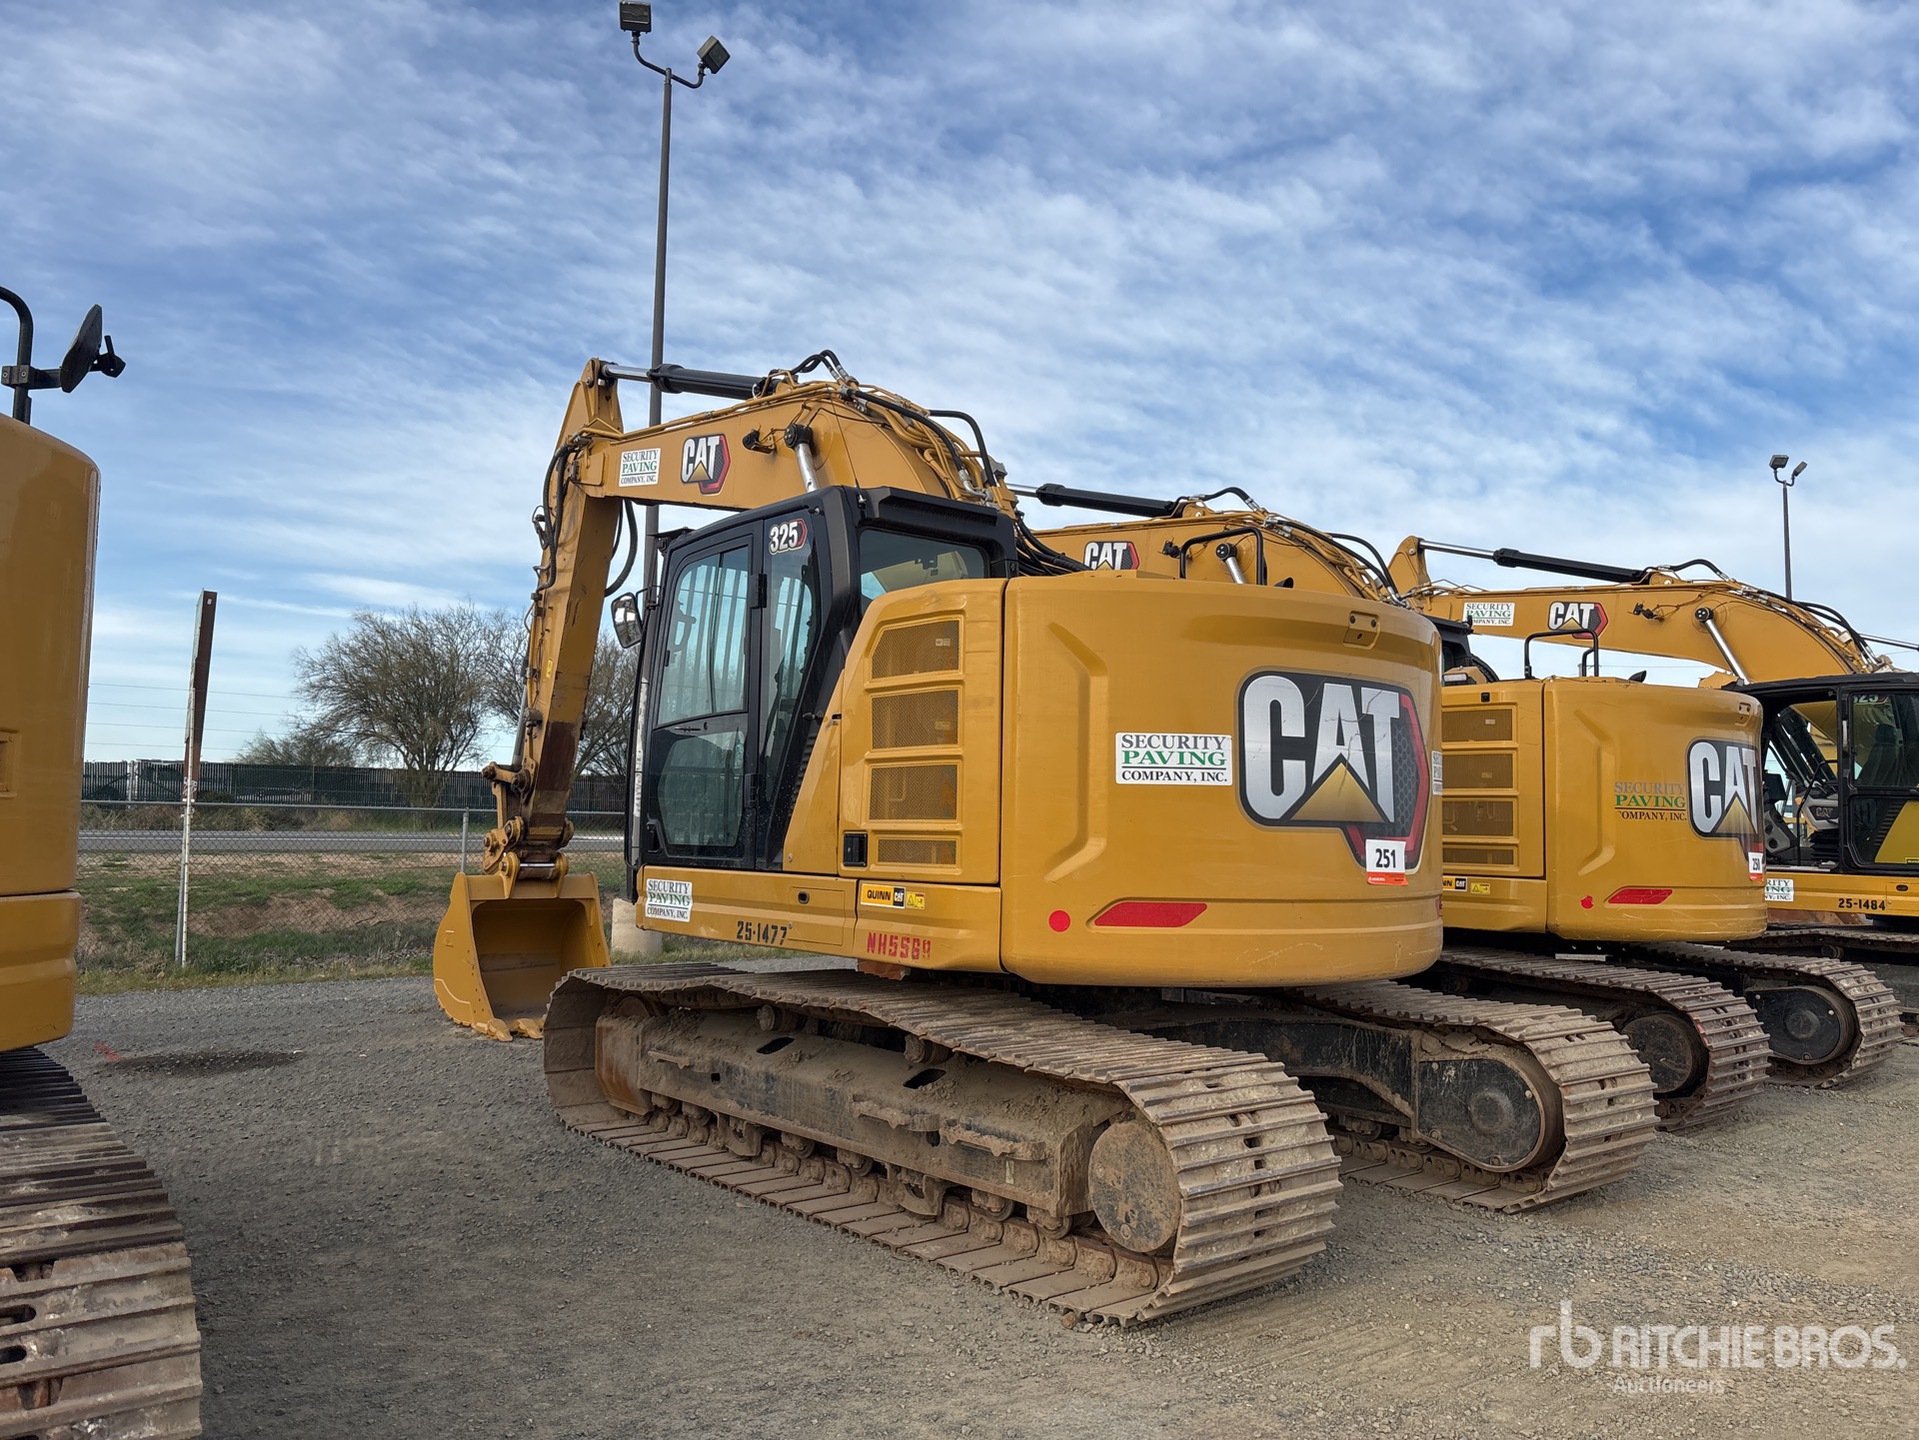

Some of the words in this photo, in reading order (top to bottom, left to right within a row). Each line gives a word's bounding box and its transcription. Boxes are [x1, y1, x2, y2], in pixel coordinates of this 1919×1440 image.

[623, 450, 659, 462] SECURITY
[682, 435, 720, 483] CAT
[622, 461, 657, 473] PAVING
[621, 476, 645, 484] COMPANY,
[769, 521, 798, 552] 325
[1084, 542, 1128, 570] CAT
[1549, 602, 1595, 630] CAT
[1121, 734, 1227, 750] SECURITY
[1244, 675, 1400, 823] CAT
[1122, 750, 1227, 766] PAVING
[1121, 770, 1197, 784] COMPANY,
[1200, 771, 1228, 783] INC.
[1614, 781, 1686, 795] SECURITY
[1689, 741, 1758, 834] CAT
[1615, 794, 1686, 808] PAVING
[1669, 812, 1687, 821] INC.
[1375, 848, 1396, 868] 251
[648, 880, 690, 894] SECURITY
[649, 892, 690, 906] PAVING
[866, 889, 891, 901] QUINN
[1838, 897, 1886, 911] 25-1484
[647, 907, 676, 918] COMPANY,
[676, 910, 688, 919] INC.
[736, 920, 788, 946] 25-1477
